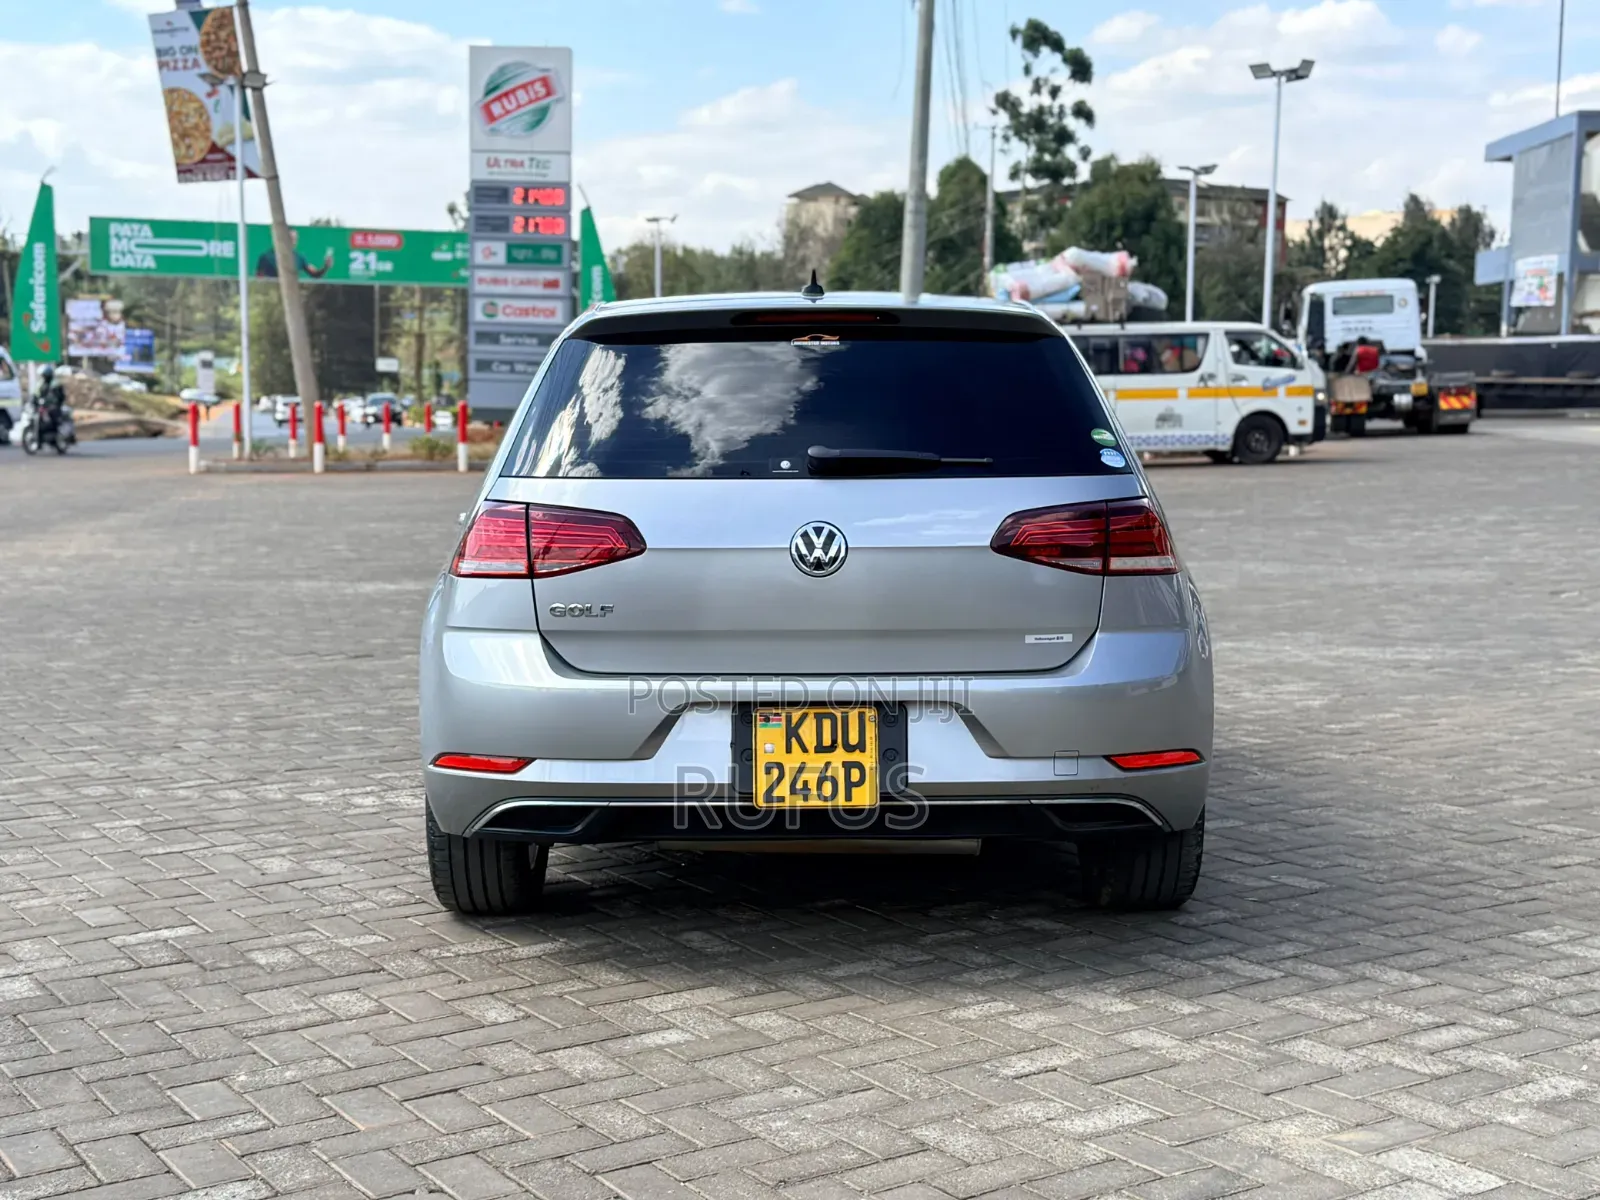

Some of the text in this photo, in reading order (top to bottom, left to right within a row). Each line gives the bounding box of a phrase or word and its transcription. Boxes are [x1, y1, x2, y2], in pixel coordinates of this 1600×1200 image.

[155, 46, 177, 58] BIG
[158, 57, 201, 72] PIZZA
[489, 79, 547, 118] RUBIS
[109, 222, 154, 238] PATA
[110, 253, 157, 269] DATA
[29, 242, 46, 333] Safaricom
[502, 304, 557, 318] Castrol
[549, 602, 614, 618] GOLF
[785, 711, 867, 754] KDU
[762, 760, 867, 803] 246P
